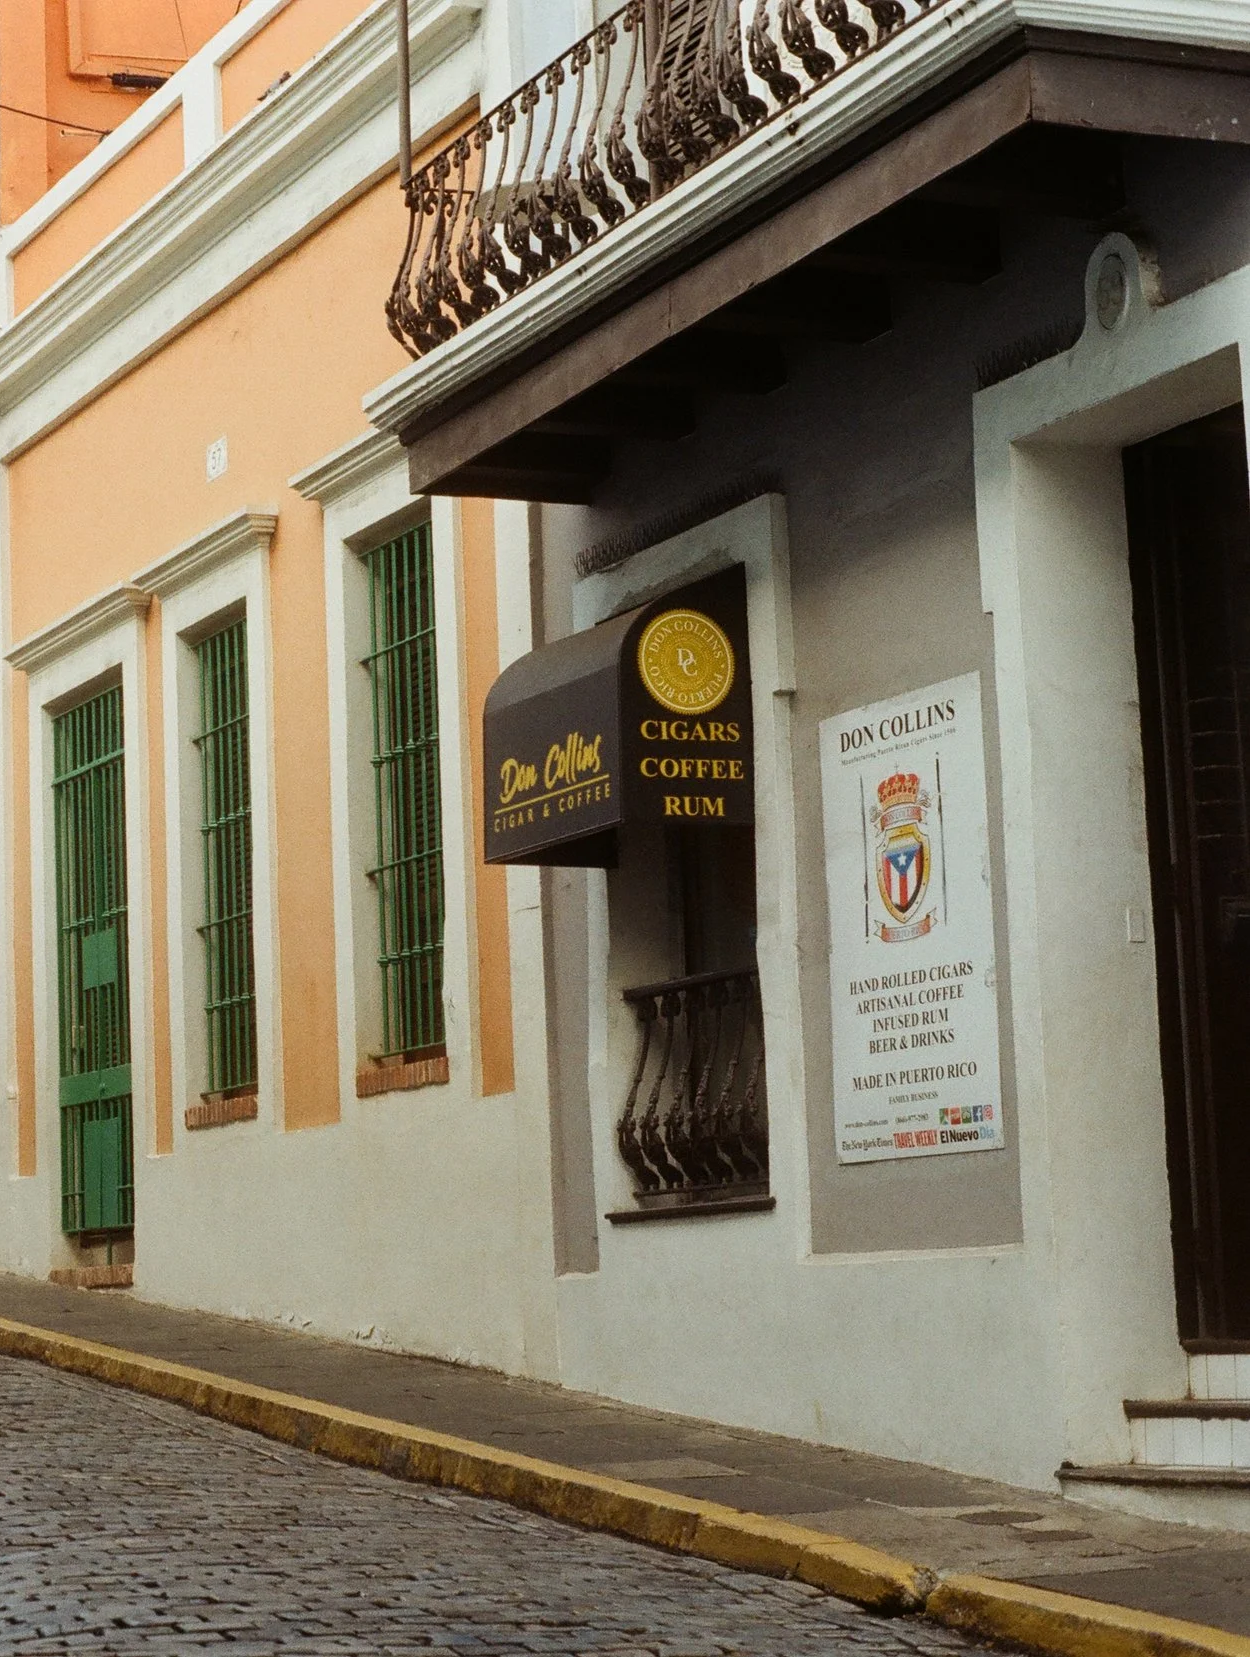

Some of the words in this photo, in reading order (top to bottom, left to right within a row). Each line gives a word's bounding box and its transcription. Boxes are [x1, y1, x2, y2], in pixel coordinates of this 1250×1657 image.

[211, 447, 221, 470] 57
[649, 625, 672, 653] DON
[674, 621, 723, 659] COLLINS
[650, 666, 675, 698] RICO
[678, 673, 724, 704] PUERTO
[640, 720, 741, 742] CIGARS
[840, 723, 874, 753] DON
[879, 699, 955, 741] COLLINS
[499, 758, 538, 804] Don
[544, 732, 602, 789] Collins
[640, 757, 744, 780] COFFEE
[494, 808, 534, 833] CIGAR
[558, 782, 611, 813] COFFEE
[664, 796, 725, 817] RUM
[850, 977, 879, 995] HAND
[882, 969, 926, 990] ROLLED
[929, 960, 973, 982] CIGARS
[856, 992, 917, 1015] ARTISANAL
[918, 984, 964, 1005] COFFEE
[873, 1013, 919, 1033] INFUSED
[922, 1008, 949, 1025] RUM
[869, 1038, 897, 1054] BEER
[899, 1035, 908, 1050] &
[911, 1028, 955, 1048] DRINKS
[853, 1074, 883, 1091] MADE
[885, 1072, 897, 1087] IN
[900, 1065, 944, 1085] PUERTO
[947, 1061, 978, 1079] RICO
[893, 1131, 915, 1149] TRAVEL
[914, 1129, 938, 1146] WEEKLY
[940, 1130, 949, 1144] El
[949, 1129, 979, 1143] Nuevo
